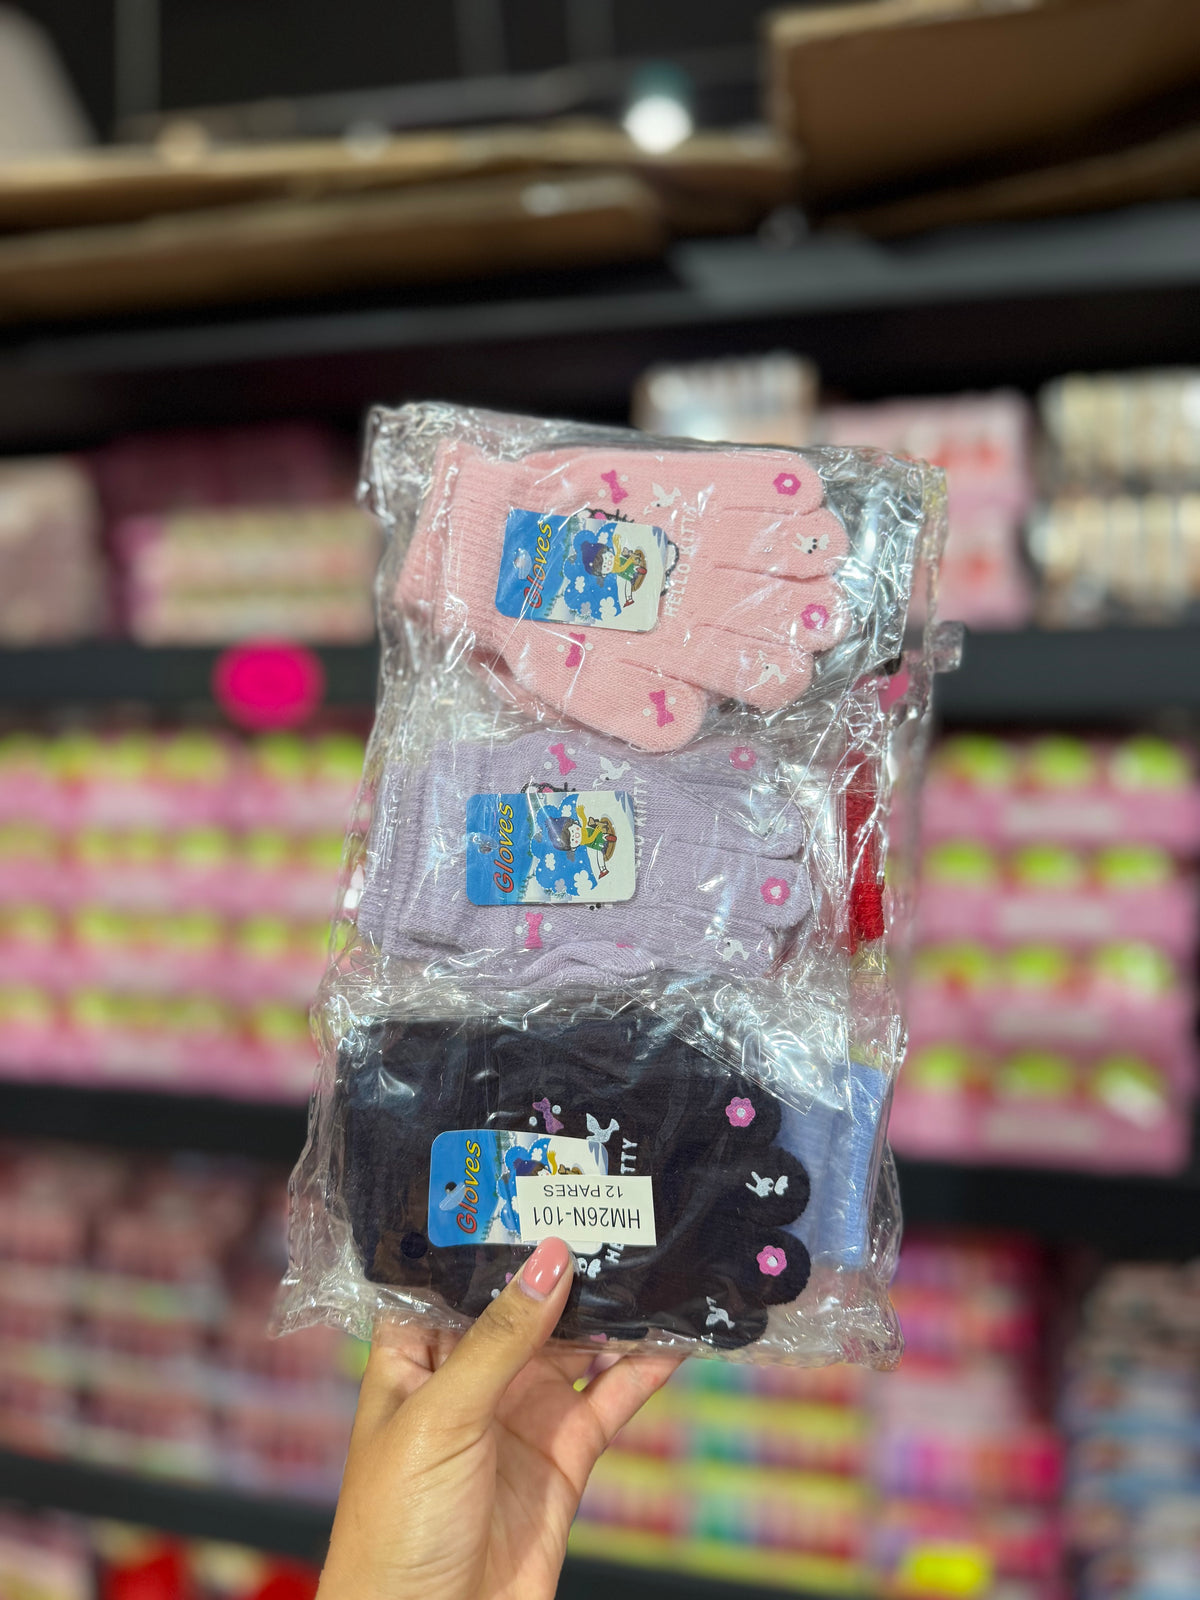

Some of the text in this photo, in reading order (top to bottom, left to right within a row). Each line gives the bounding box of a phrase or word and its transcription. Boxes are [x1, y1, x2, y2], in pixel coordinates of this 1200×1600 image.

[523, 522, 552, 609] Gloves
[664, 563, 691, 617] HELLO
[493, 801, 514, 893] Gloves
[620, 1138, 638, 1175] TTY
[456, 1139, 481, 1234] Gloves
[543, 1183, 624, 1199] 12 PARES
[533, 1206, 641, 1230] HM26N-101
